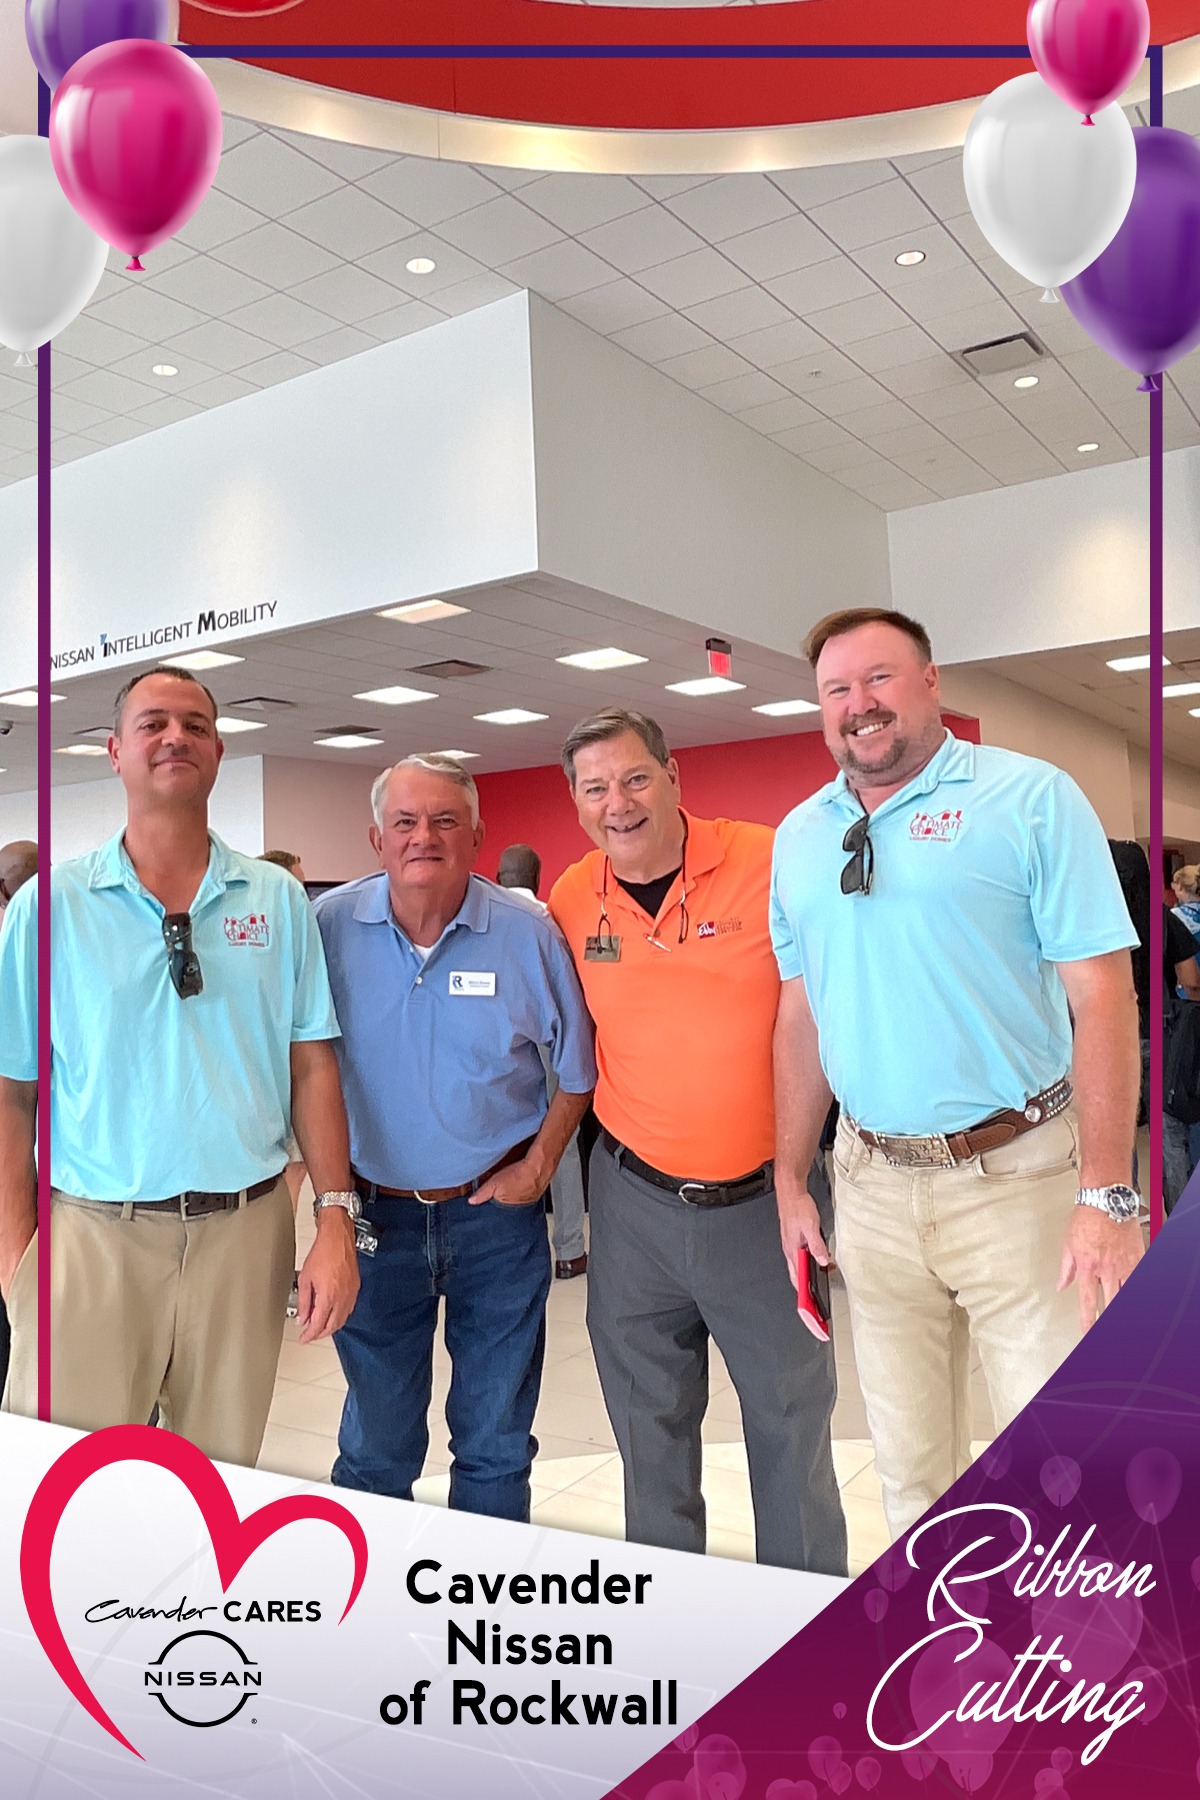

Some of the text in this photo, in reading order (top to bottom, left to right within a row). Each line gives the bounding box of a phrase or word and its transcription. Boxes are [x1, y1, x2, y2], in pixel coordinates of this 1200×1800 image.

[50, 600, 278, 670] NISSAN INTELLIGENT MOBILITY
